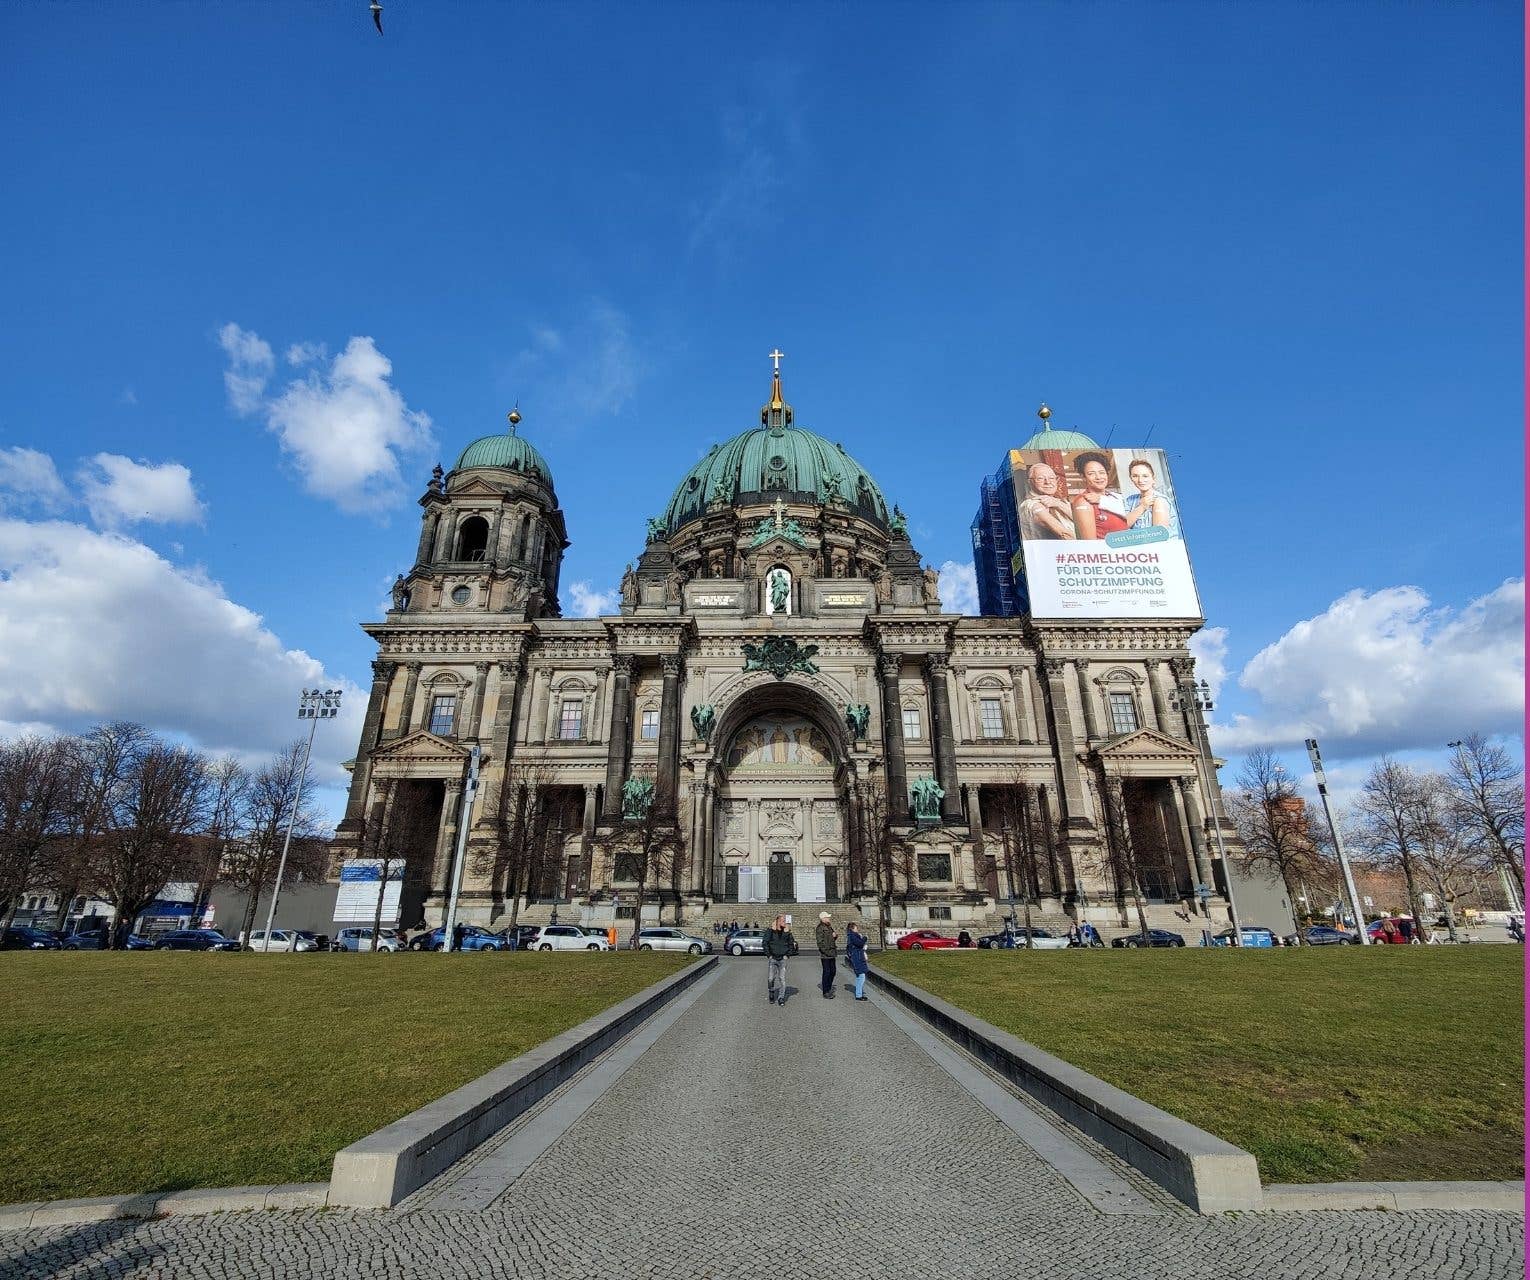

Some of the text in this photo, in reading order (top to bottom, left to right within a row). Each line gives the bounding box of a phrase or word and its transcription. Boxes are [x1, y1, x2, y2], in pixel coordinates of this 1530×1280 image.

[1056, 552, 1159, 564] #ÄRMELHOCH
[1057, 564, 1161, 575] FÜR DIE CORONA
[1058, 577, 1164, 587] SCHUTZIMPFUNG
